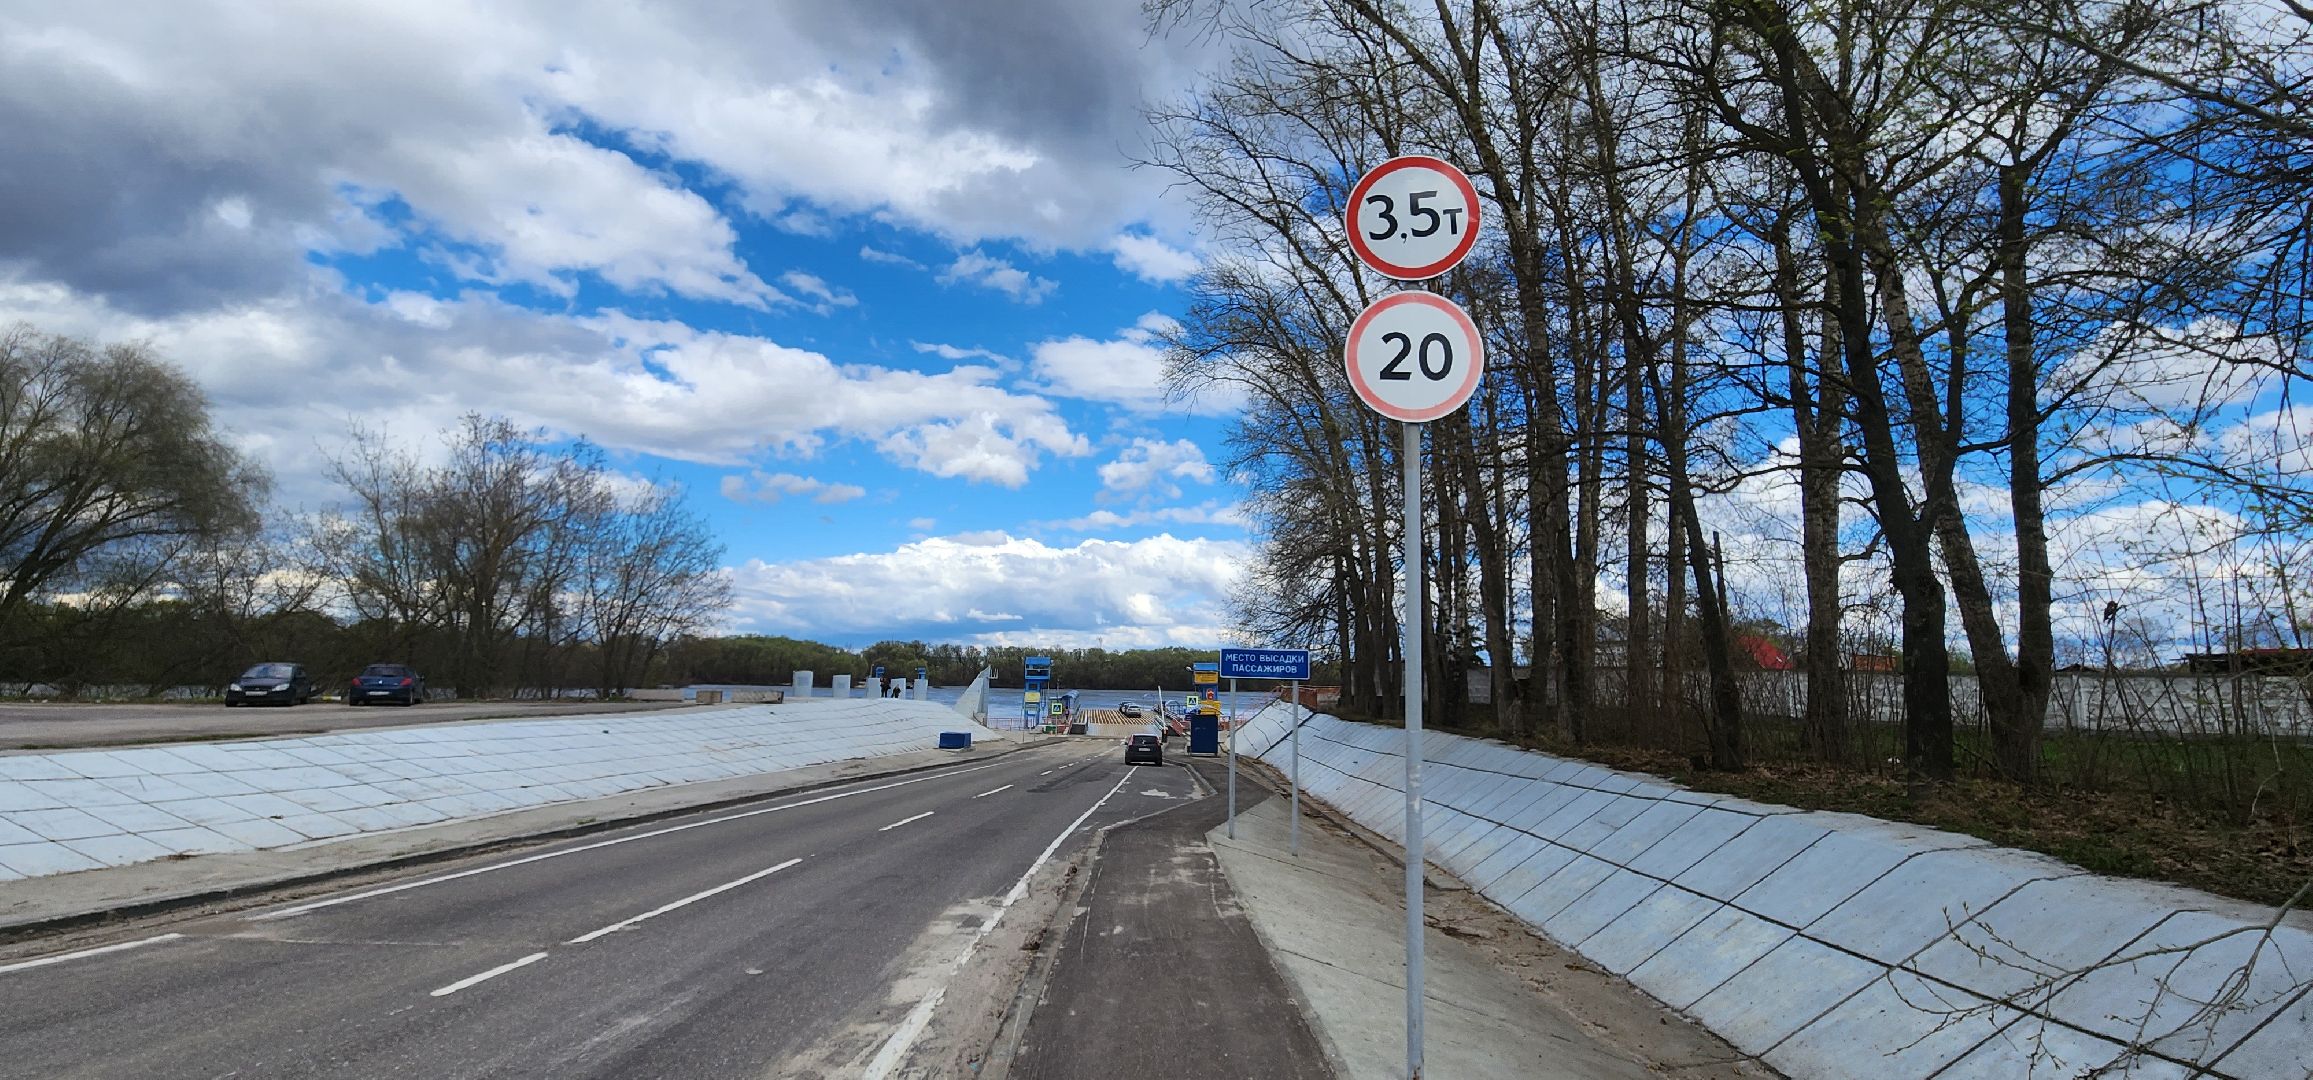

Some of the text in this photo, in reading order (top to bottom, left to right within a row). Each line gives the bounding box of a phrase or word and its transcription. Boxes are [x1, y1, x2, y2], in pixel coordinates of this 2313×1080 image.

[1380, 331, 1454, 382] 20
[1225, 653, 1304, 664] МЕСТО ВЫСАДКИ
[1232, 664, 1298, 673] ПАССАЖИРОВ
